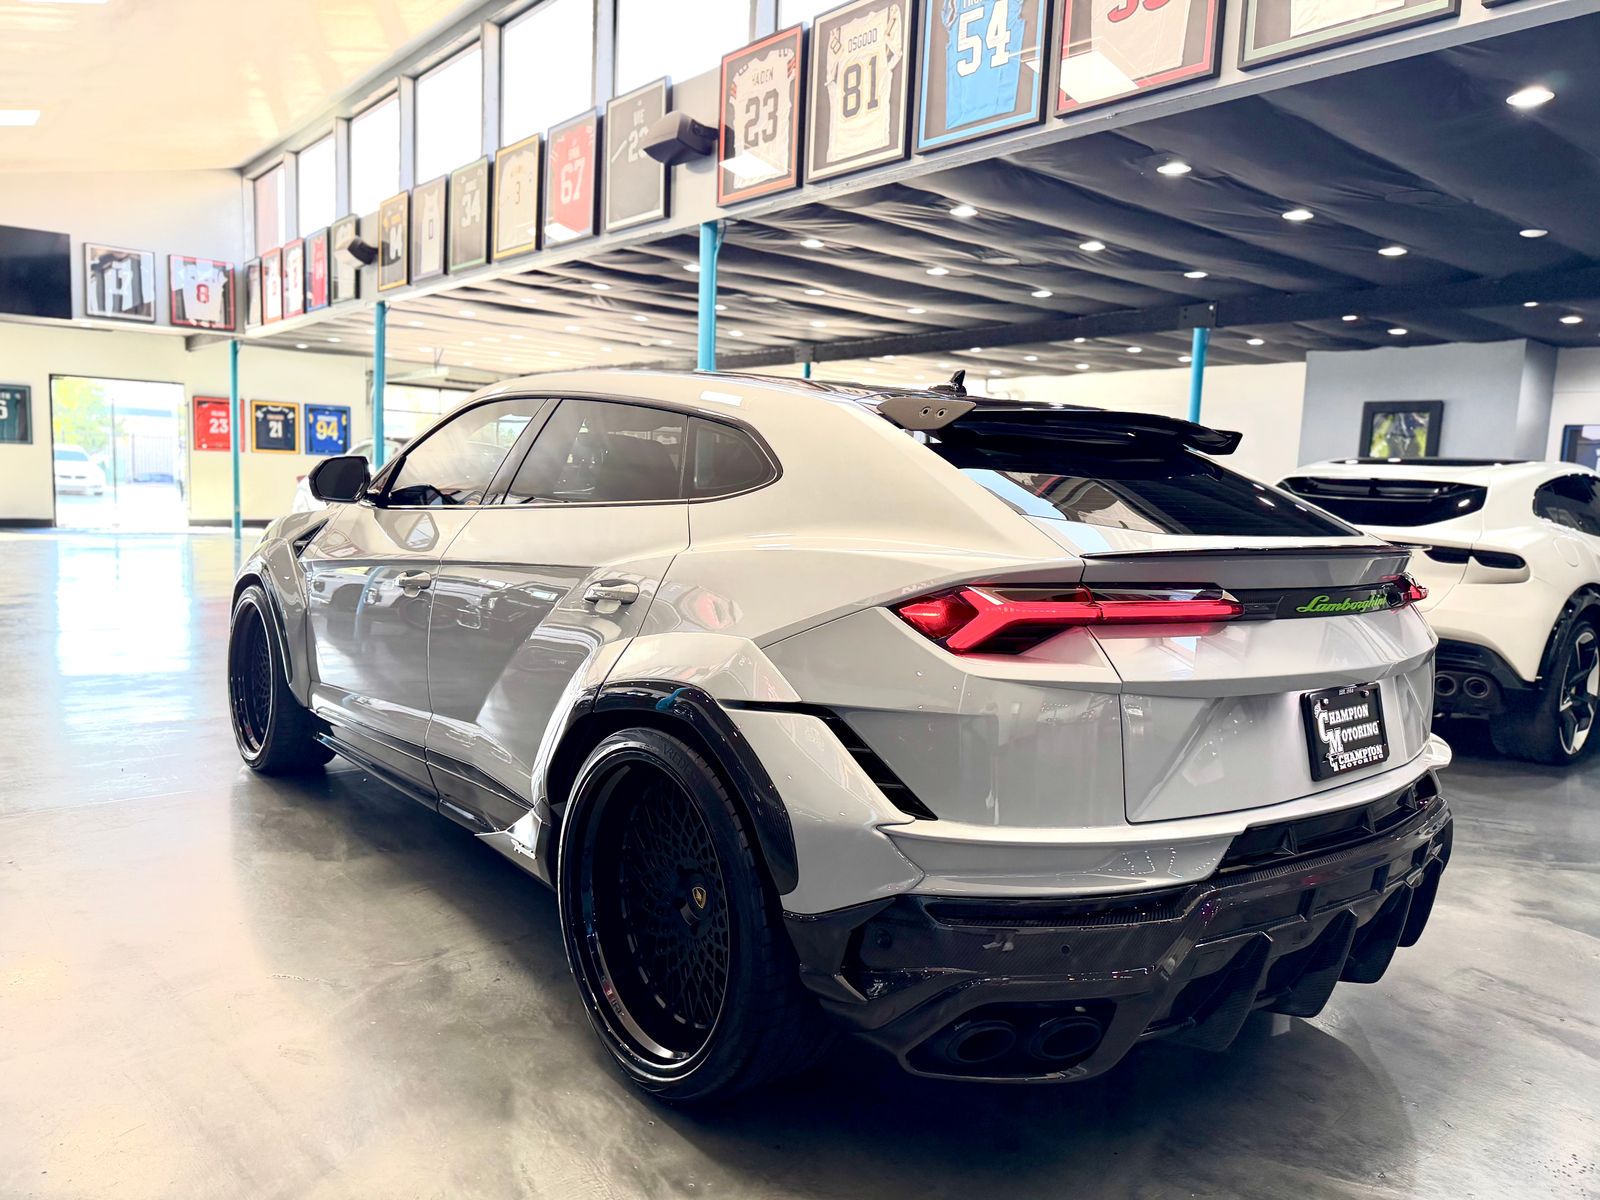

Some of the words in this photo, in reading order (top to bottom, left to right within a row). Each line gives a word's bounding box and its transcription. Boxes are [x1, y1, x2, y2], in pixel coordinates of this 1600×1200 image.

[848, 27, 878, 53] OSGOOD
[956, 0, 1011, 77] 54
[842, 55, 878, 118] 81
[744, 88, 779, 147] 23
[560, 157, 585, 204] 67
[460, 189, 481, 228] 34
[209, 417, 229, 434] 23
[268, 420, 283, 438] 21
[315, 421, 339, 441] 94
[1317, 703, 1369, 744] CHAMPION
[1326, 721, 1380, 755] MOTORING
[1338, 744, 1383, 765] CHAMPION
[1340, 753, 1384, 770] MOTORING
